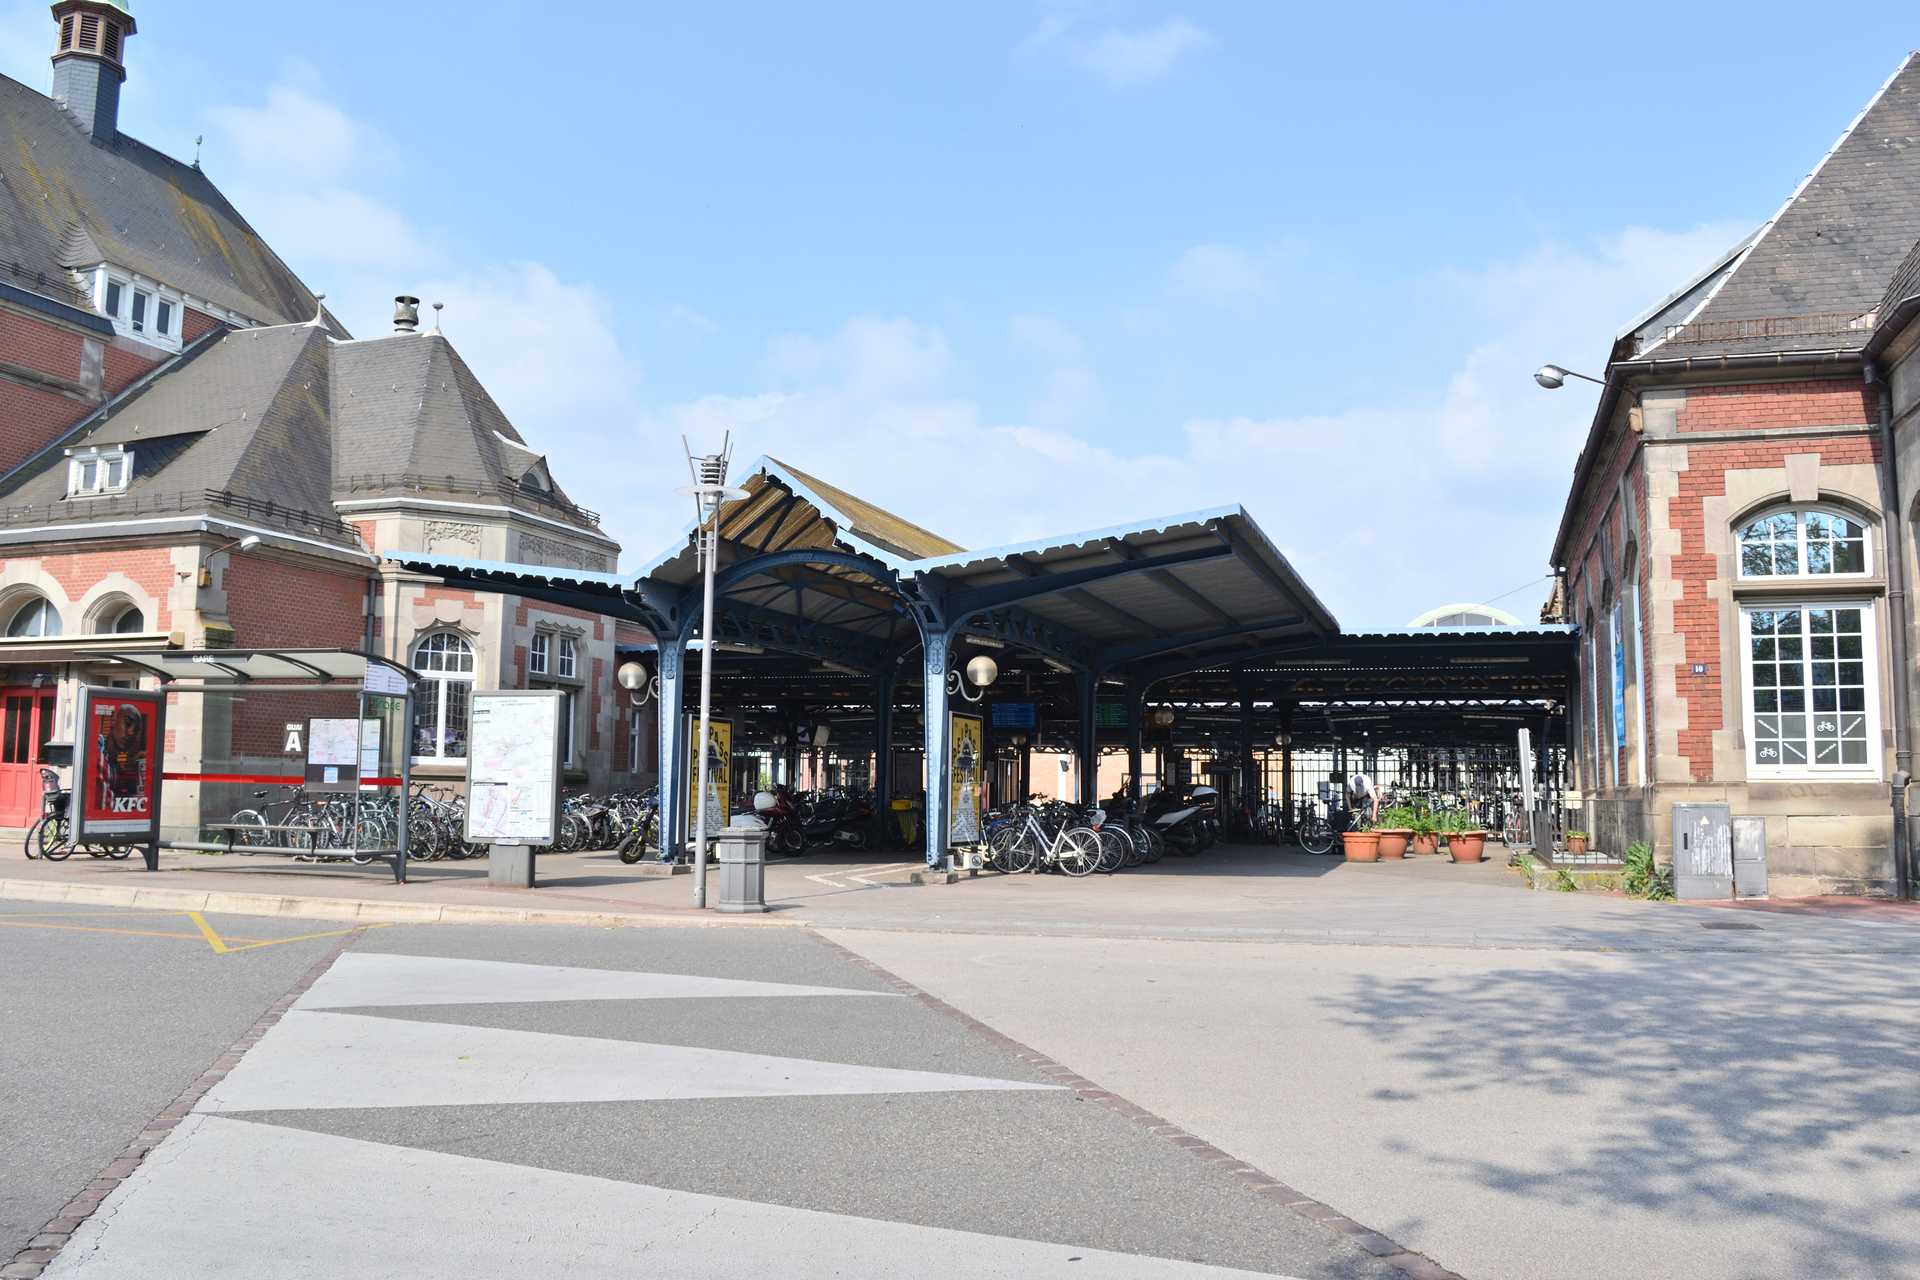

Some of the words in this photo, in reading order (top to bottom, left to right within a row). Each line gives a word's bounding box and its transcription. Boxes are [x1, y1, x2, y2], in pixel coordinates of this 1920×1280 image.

[192, 654, 215, 663] GARE
[285, 731, 302, 752] A
[693, 725, 729, 768] PPASS
[112, 797, 148, 813] KFC
